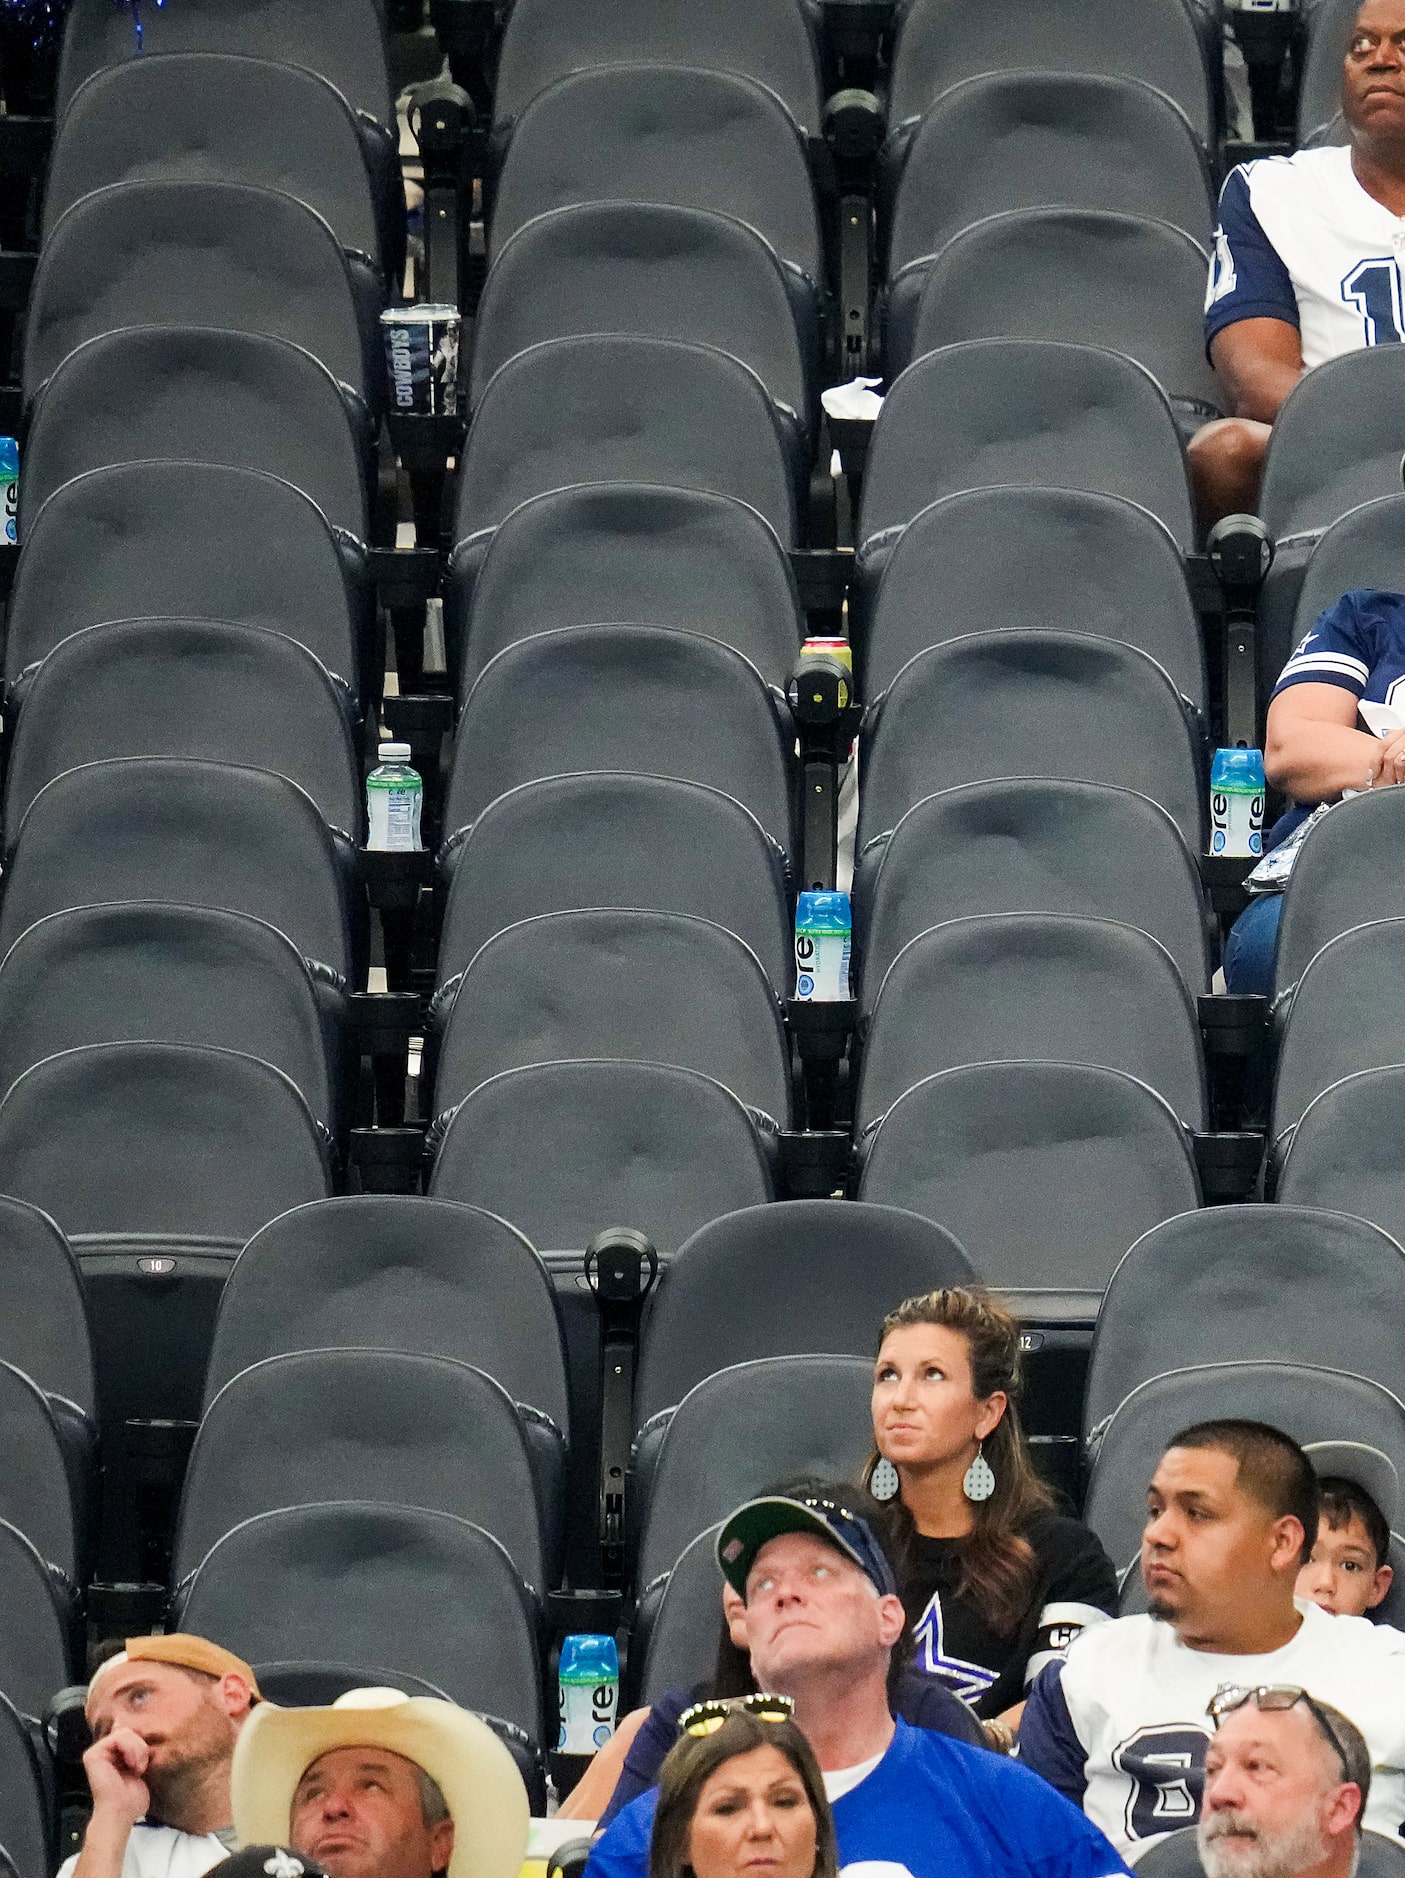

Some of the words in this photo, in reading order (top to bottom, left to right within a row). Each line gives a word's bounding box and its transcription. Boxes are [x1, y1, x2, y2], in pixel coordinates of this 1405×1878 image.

[390, 329, 413, 407] COWBOYS
[5, 482, 17, 546] ore
[1213, 794, 1227, 855] ore
[1248, 797, 1263, 856] ore
[796, 936, 814, 1001] ore
[151, 1260, 162, 1271] 10
[1020, 1336, 1032, 1349] 12
[592, 1686, 613, 1754] ore
